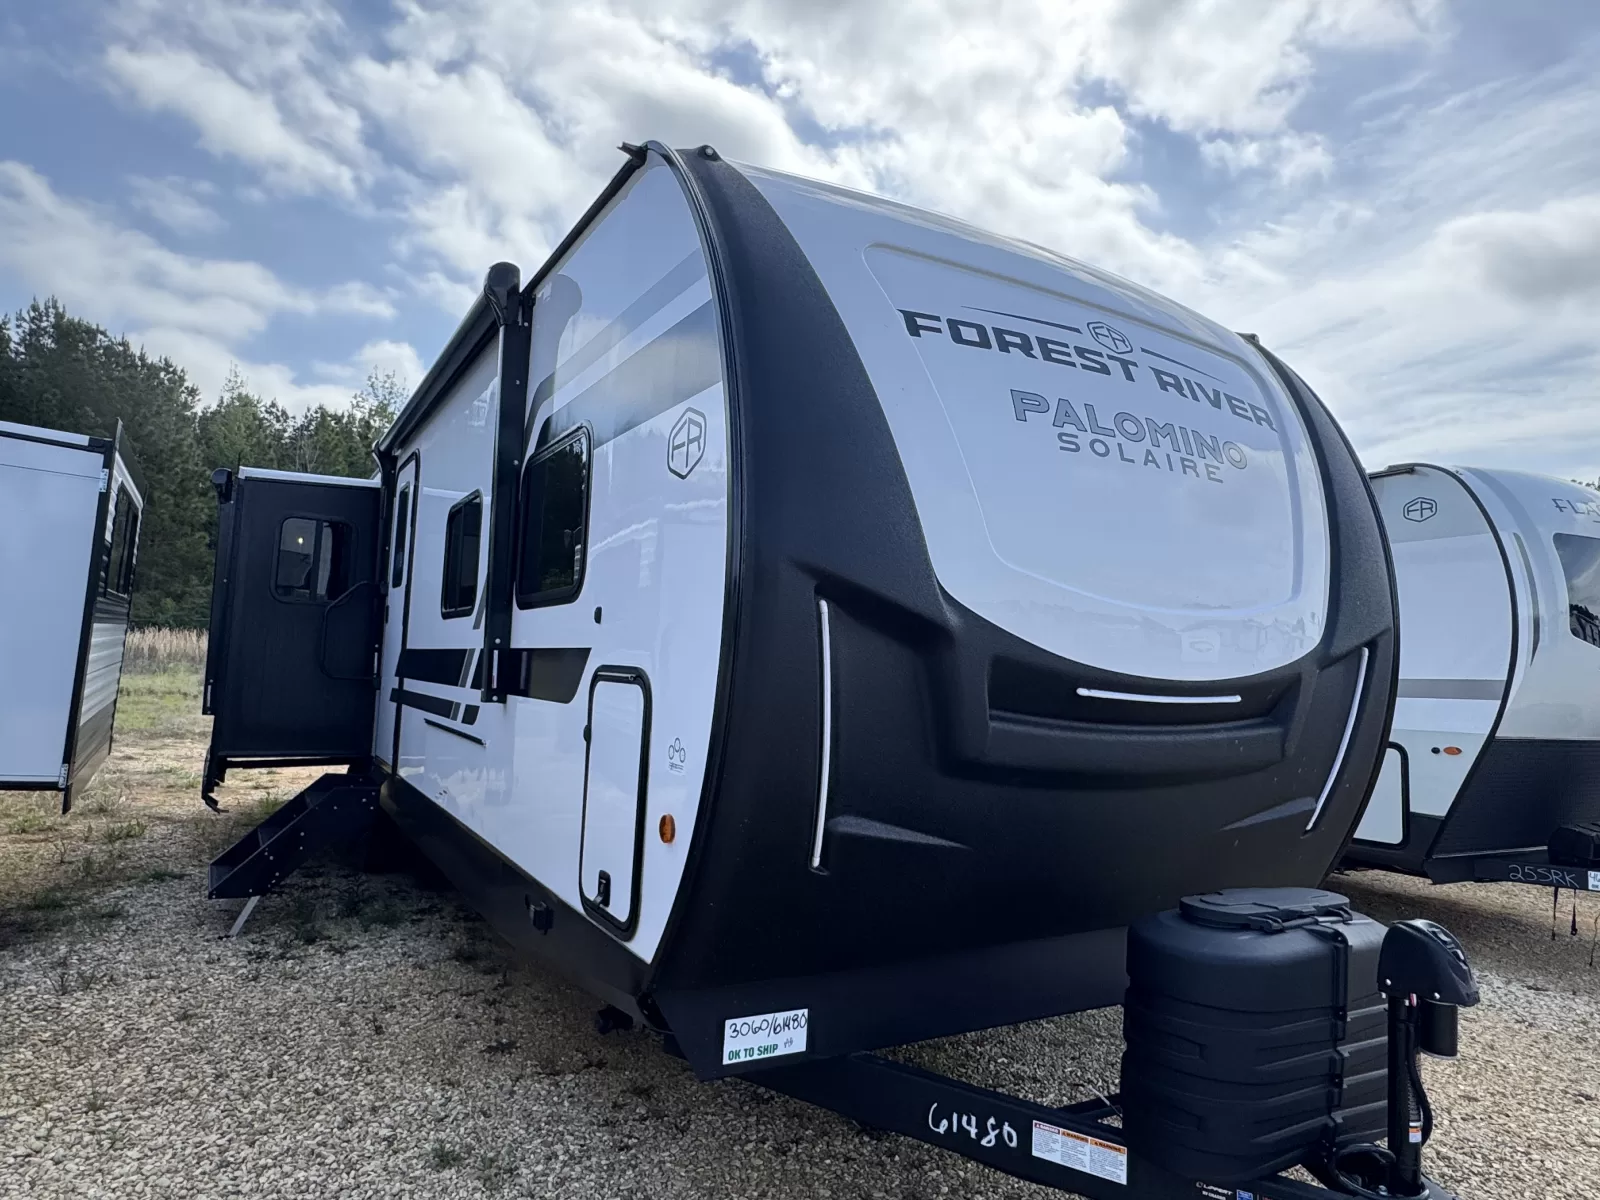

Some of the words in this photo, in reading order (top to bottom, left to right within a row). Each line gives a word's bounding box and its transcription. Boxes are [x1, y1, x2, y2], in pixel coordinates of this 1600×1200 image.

[896, 308, 1139, 383] FOREST
[1147, 365, 1280, 433] RIVER
[1009, 388, 1248, 470] PALOMINO
[1056, 432, 1224, 484] SOLAIRE
[1551, 498, 1600, 517] FLA
[728, 1049, 742, 1061] OK
[743, 1046, 755, 1059] TO
[757, 1043, 779, 1057] SHIP
[928, 1102, 1018, 1148] 61480
